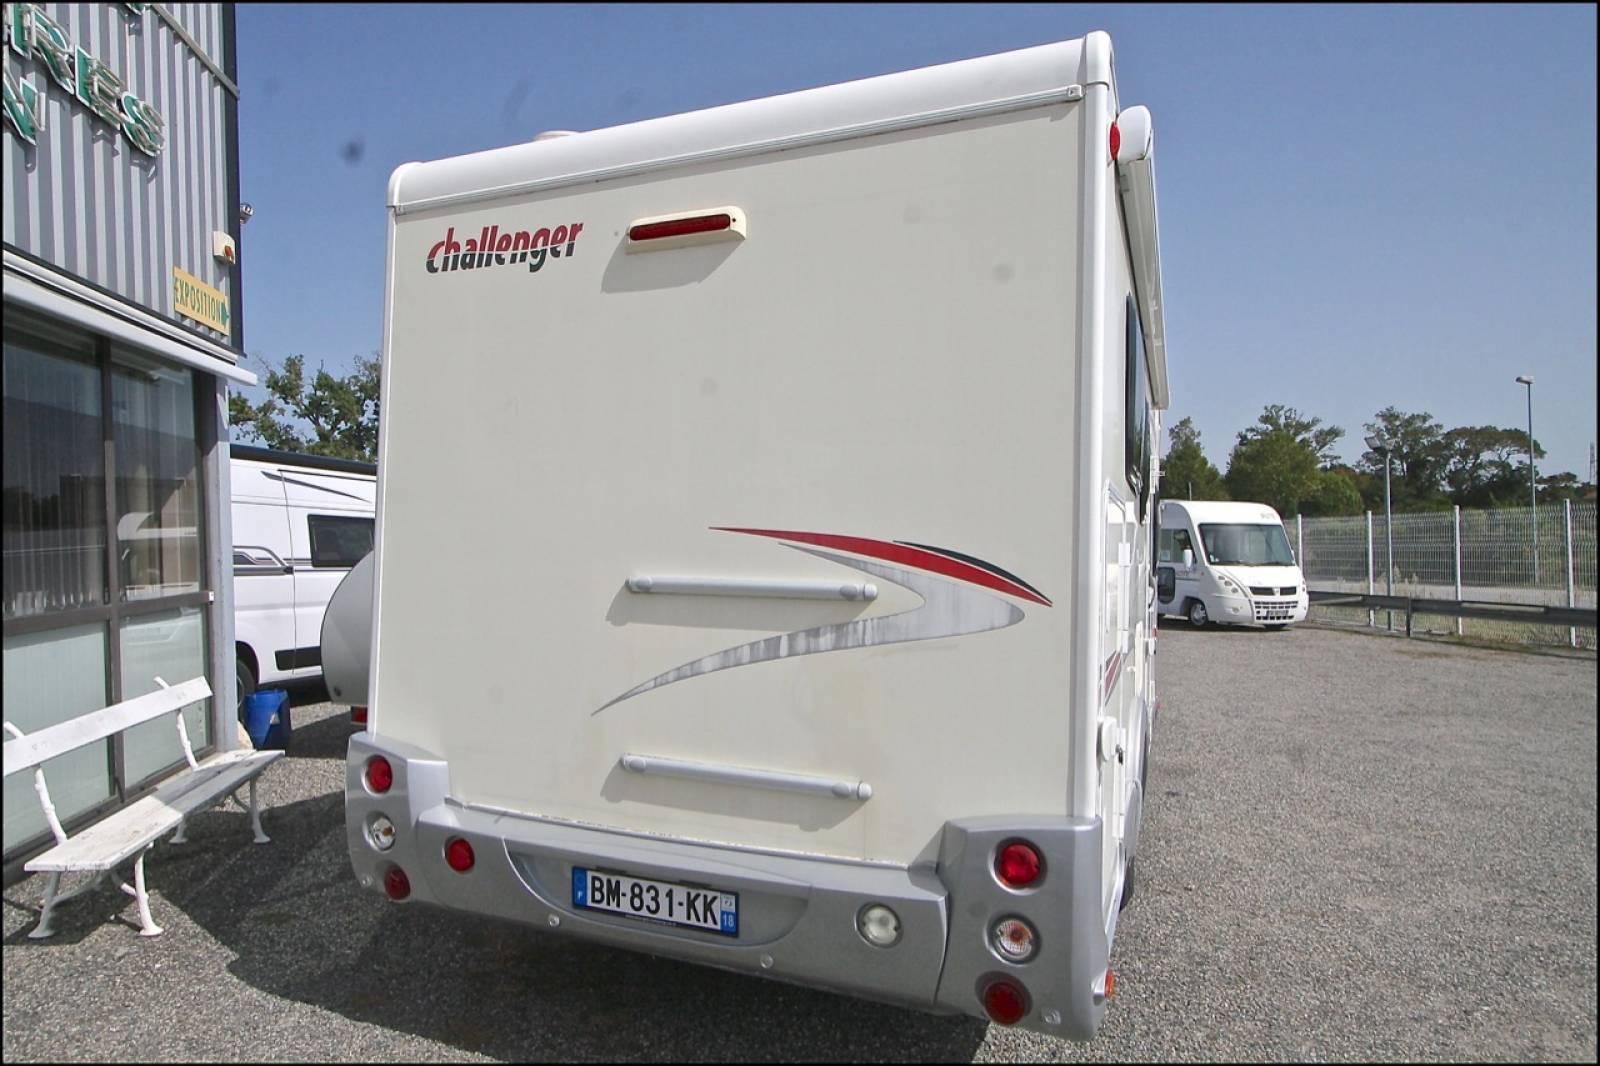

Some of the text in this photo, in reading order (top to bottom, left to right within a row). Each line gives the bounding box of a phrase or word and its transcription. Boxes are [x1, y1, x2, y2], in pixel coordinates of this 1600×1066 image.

[4, 3, 166, 157] RES
[426, 222, 584, 273] challenger
[175, 277, 221, 325] EXPOSITION
[590, 875, 719, 926] BM-831-KK
[723, 913, 735, 928] 18
